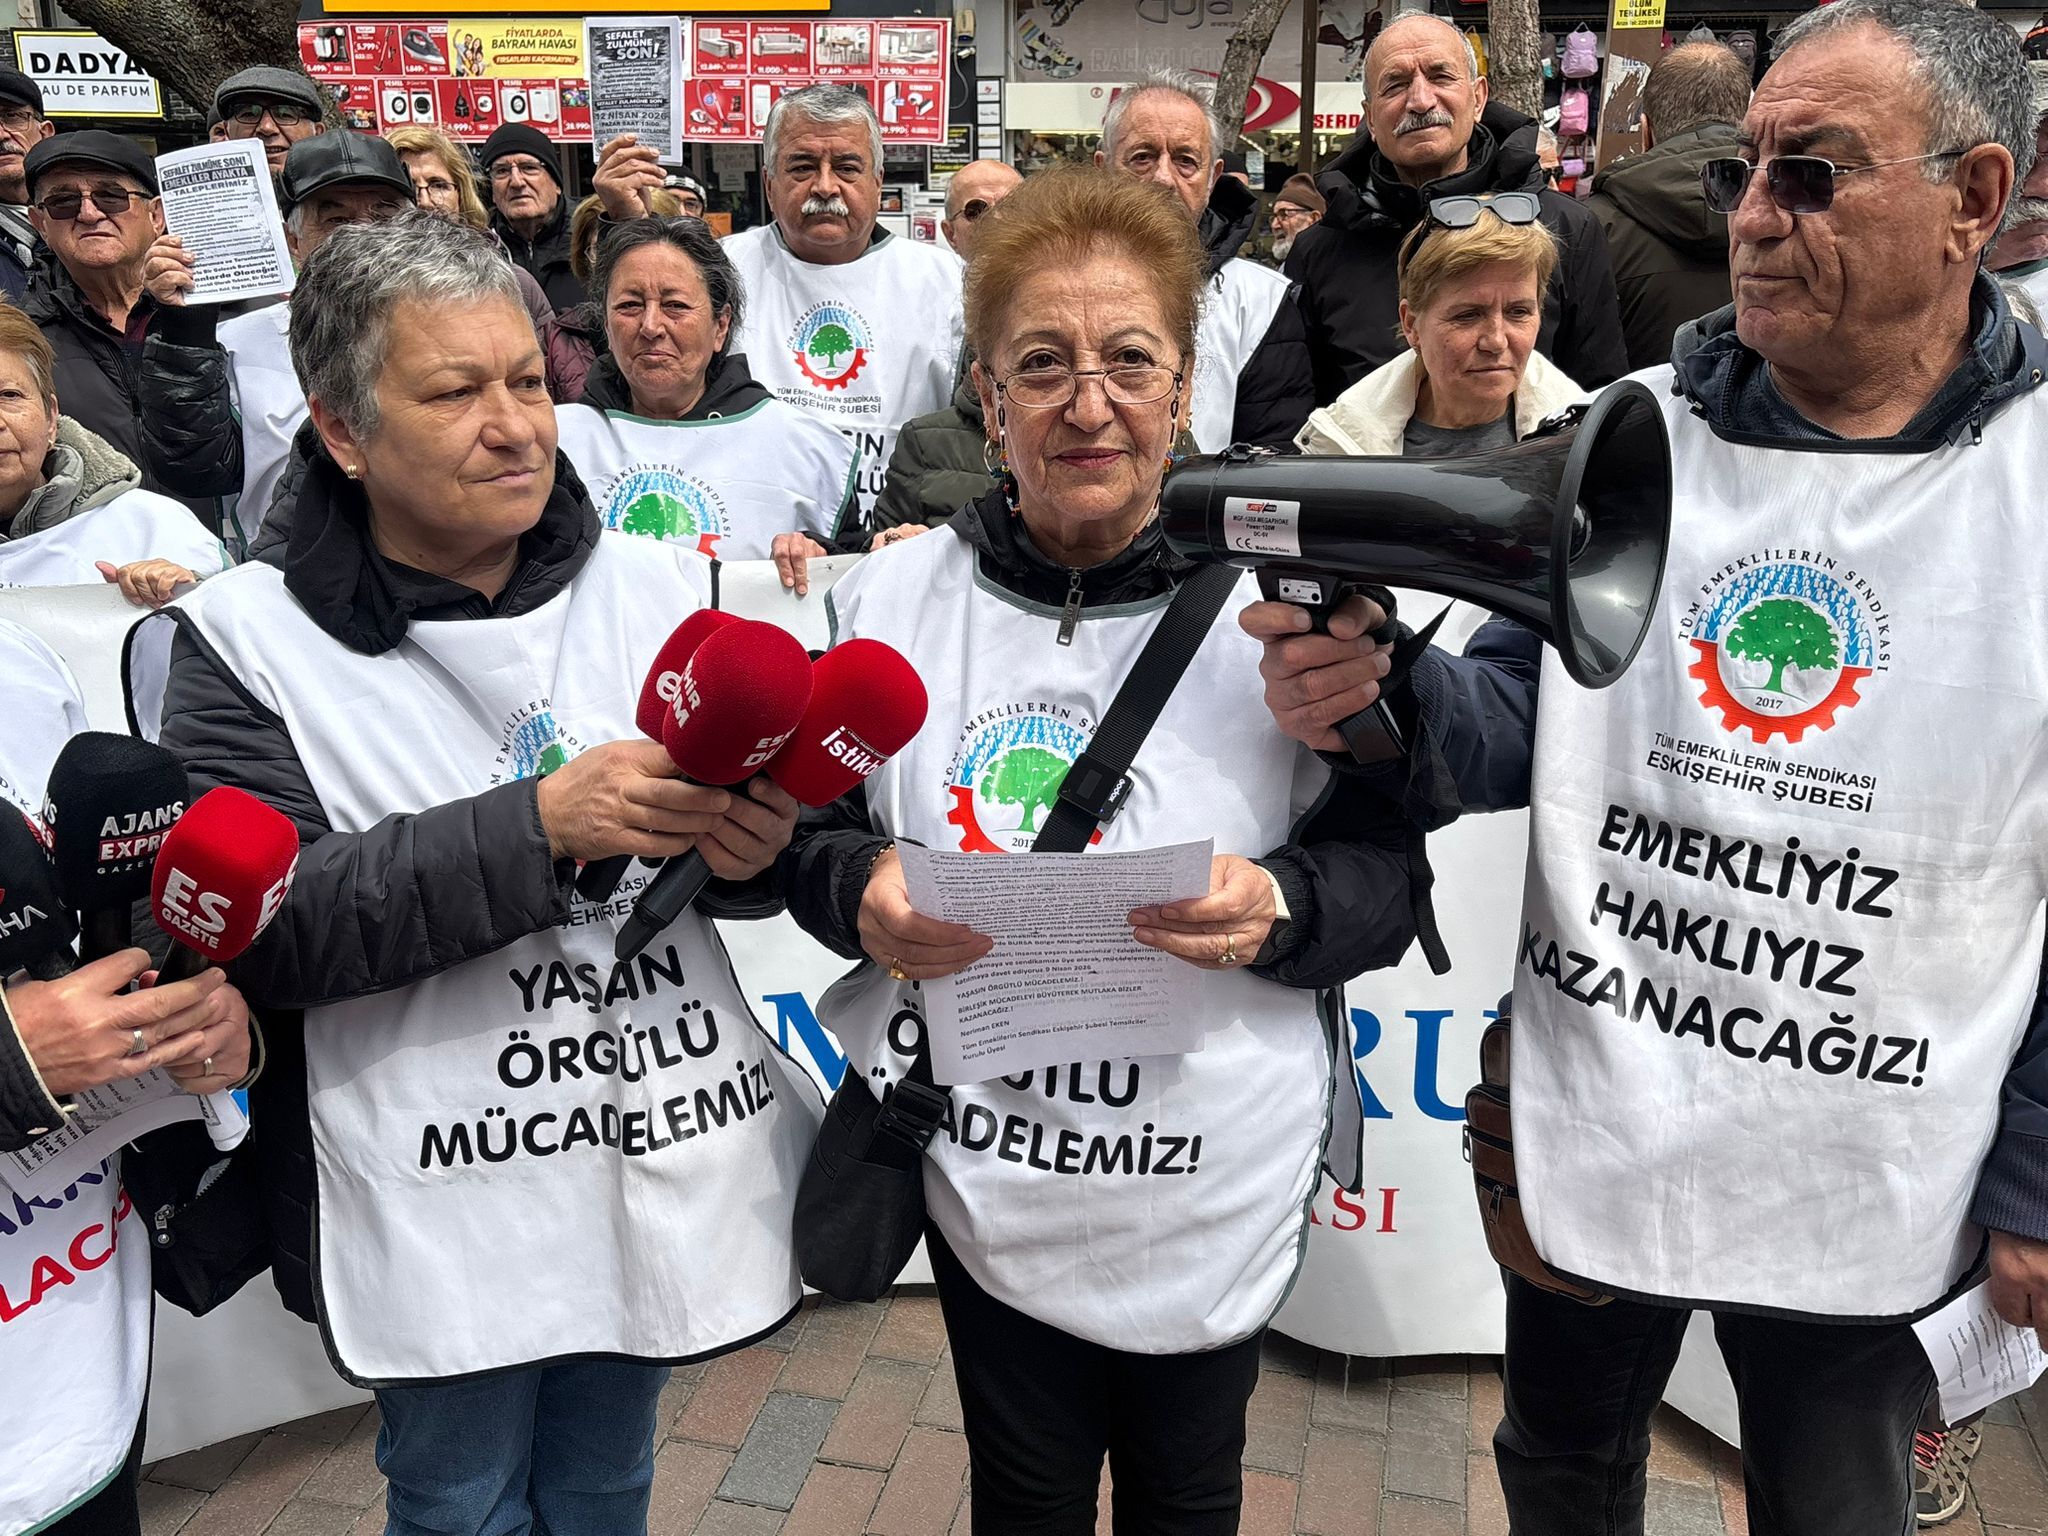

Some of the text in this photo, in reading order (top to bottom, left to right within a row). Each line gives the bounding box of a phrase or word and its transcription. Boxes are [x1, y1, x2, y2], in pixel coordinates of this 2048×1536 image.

[505, 27, 563, 38] FİYATLARDA
[605, 30, 644, 41] SEFALET
[491, 39, 577, 49] BAYRAM HAVASI
[606, 38, 653, 50] ZULMÜNE
[616, 42, 660, 61] SON!
[30, 52, 145, 75] DADYA
[38, 85, 150, 97] AU DE PARFUM
[608, 111, 639, 120] NİSAN
[163, 156, 247, 179] SEFALET ZULMÜNE SON!
[212, 167, 249, 181] AYAKTA
[173, 178, 249, 197] TALEPLERİMİZ
[777, 387, 882, 404] TÜM EMEKLİLERİN SENDİKASI
[839, 402, 882, 414] ŞUBESİ
[602, 463, 732, 539] EMEKLİLERİN SENDİKASI
[1677, 549, 1892, 672] TÜM EMEKLİLERİN SENDİKASI
[1755, 696, 1783, 710] 2017
[959, 702, 1071, 743] EMEKLİLERİN
[1654, 732, 1877, 790] TÜM EMEKLİLERİN SENDİKASI
[1646, 749, 1874, 813] ESKİŞEHİR ŞUBESİ
[100, 801, 185, 837] AJANS
[1598, 803, 1900, 919] EMEKLİYİZ
[161, 867, 233, 934] ES
[161, 907, 221, 950] GAZETE
[1589, 881, 1866, 997] HAKLIYIZ
[973, 960, 1003, 972] çıkmaya
[1015, 958, 1060, 966] sendikamıza
[954, 973, 990, 986] katılmaya
[990, 970, 1011, 978] davet
[956, 985, 987, 1001] YAŞASIN
[987, 980, 1023, 992] ÖRGÜTLÜ
[957, 985, 1143, 1015] BİRLEŞİK MÜCADELEYİ BÜYÜTEREK MUTLAKA BİZLER
[1519, 920, 1930, 1088] KAZANACAĞIZ!
[960, 1020, 1011, 1038] Neriman EKEN
[961, 1042, 978, 1051] Tüm
[1018, 1028, 1052, 1038] Sendikası
[1052, 1023, 1084, 1034] Eskişehir
[1085, 1020, 1109, 1031] Şubesi
[1109, 1018, 1148, 1028] Temsilciler
[962, 1044, 1007, 1061] Kurulu Üyesi
[419, 1058, 775, 1170] MÜCADELEMİZ!
[1310, 1187, 1401, 1233] SI
